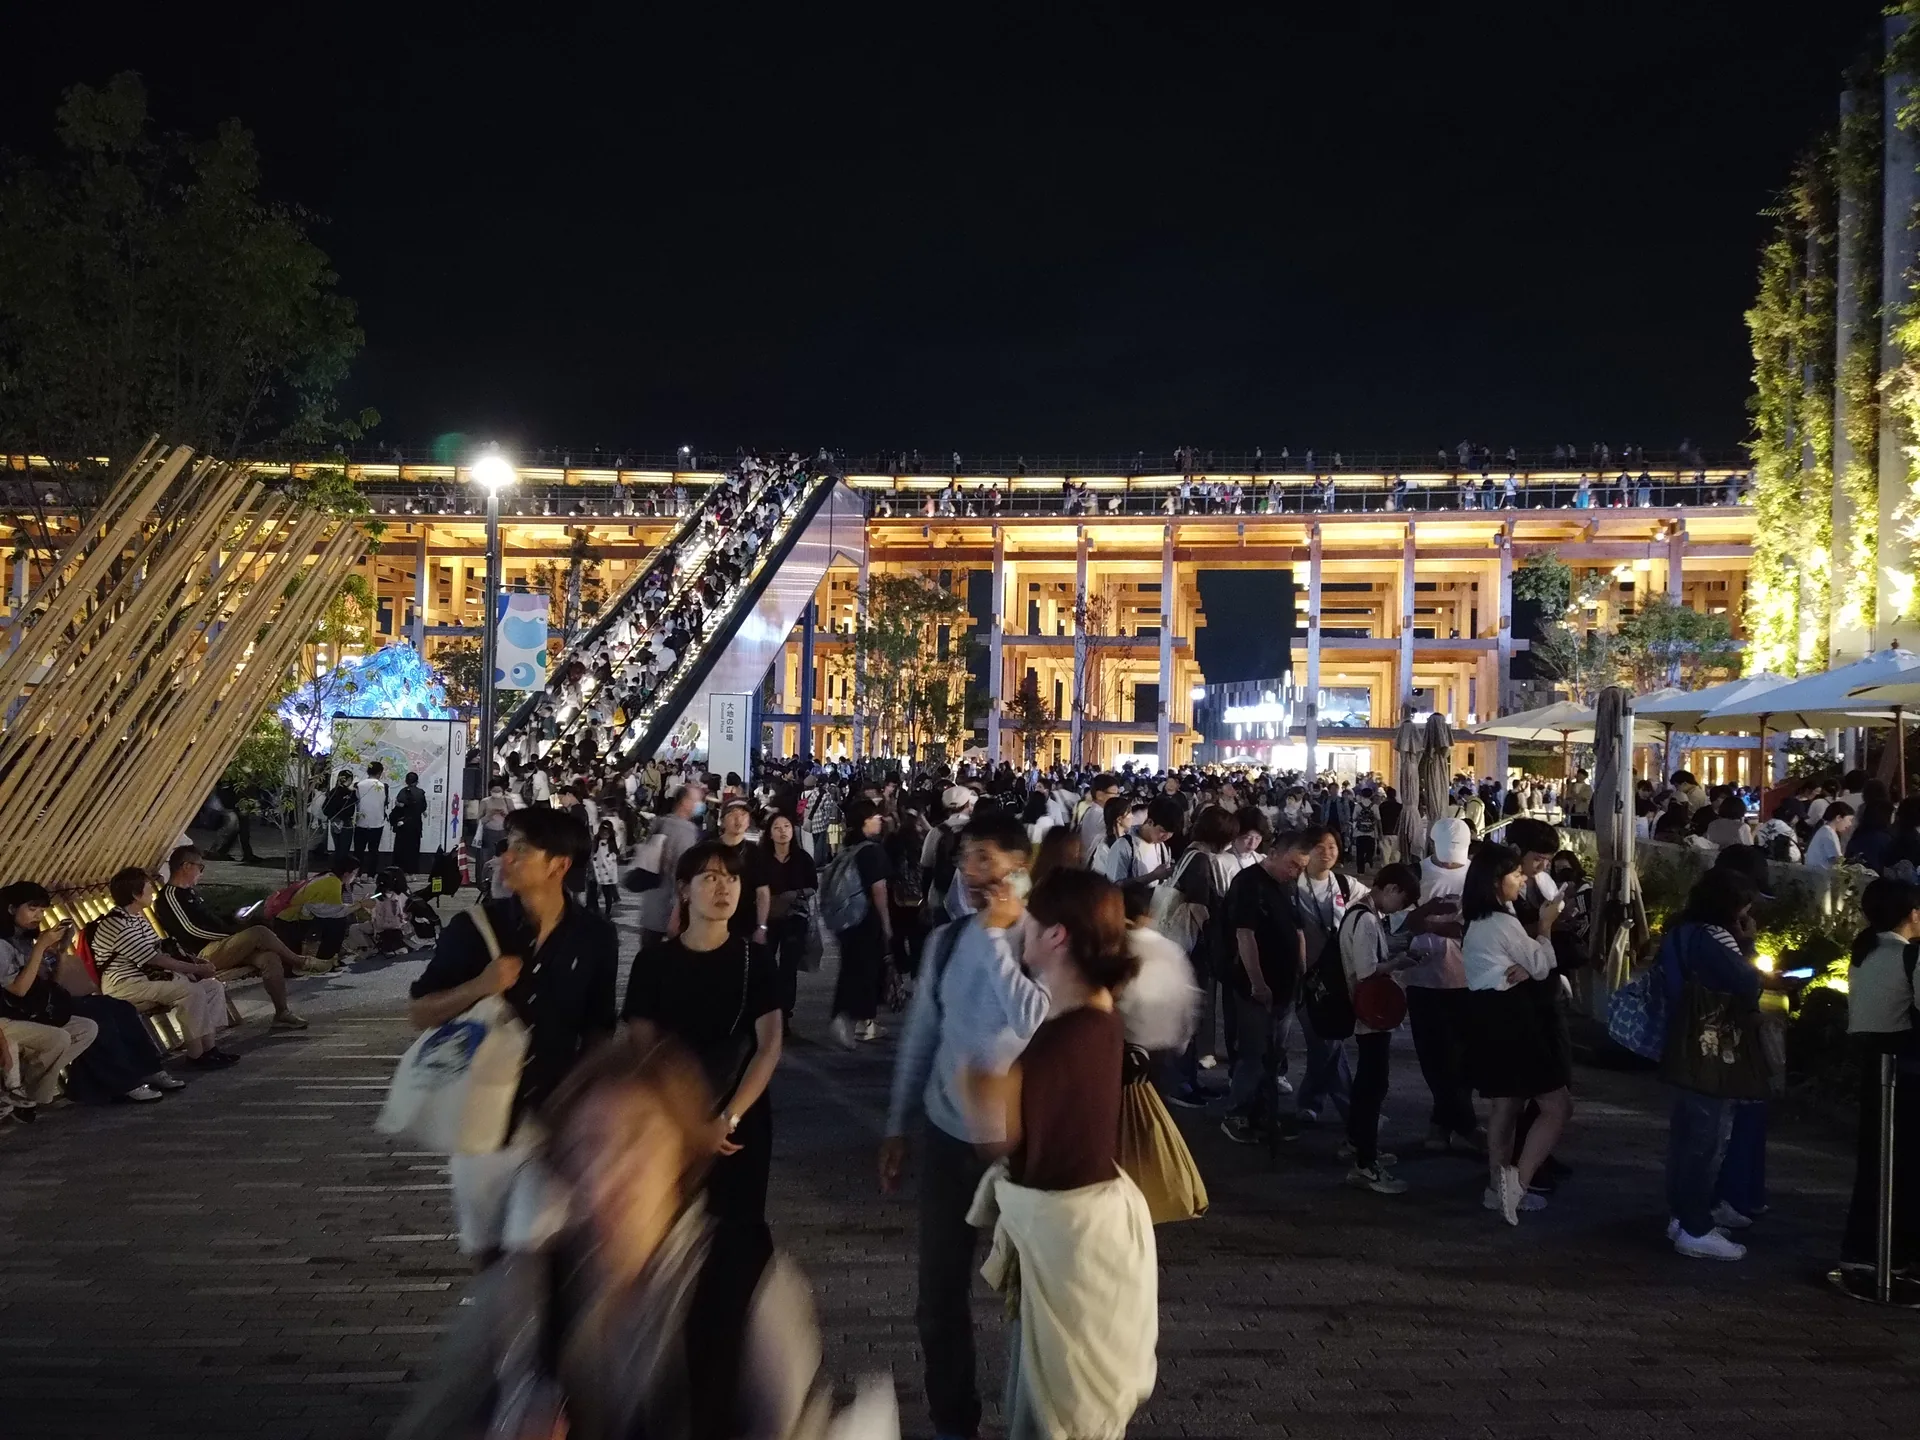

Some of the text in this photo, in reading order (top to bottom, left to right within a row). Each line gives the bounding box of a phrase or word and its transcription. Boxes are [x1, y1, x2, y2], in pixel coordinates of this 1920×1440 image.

[726, 702, 734, 741] 大地の広場
